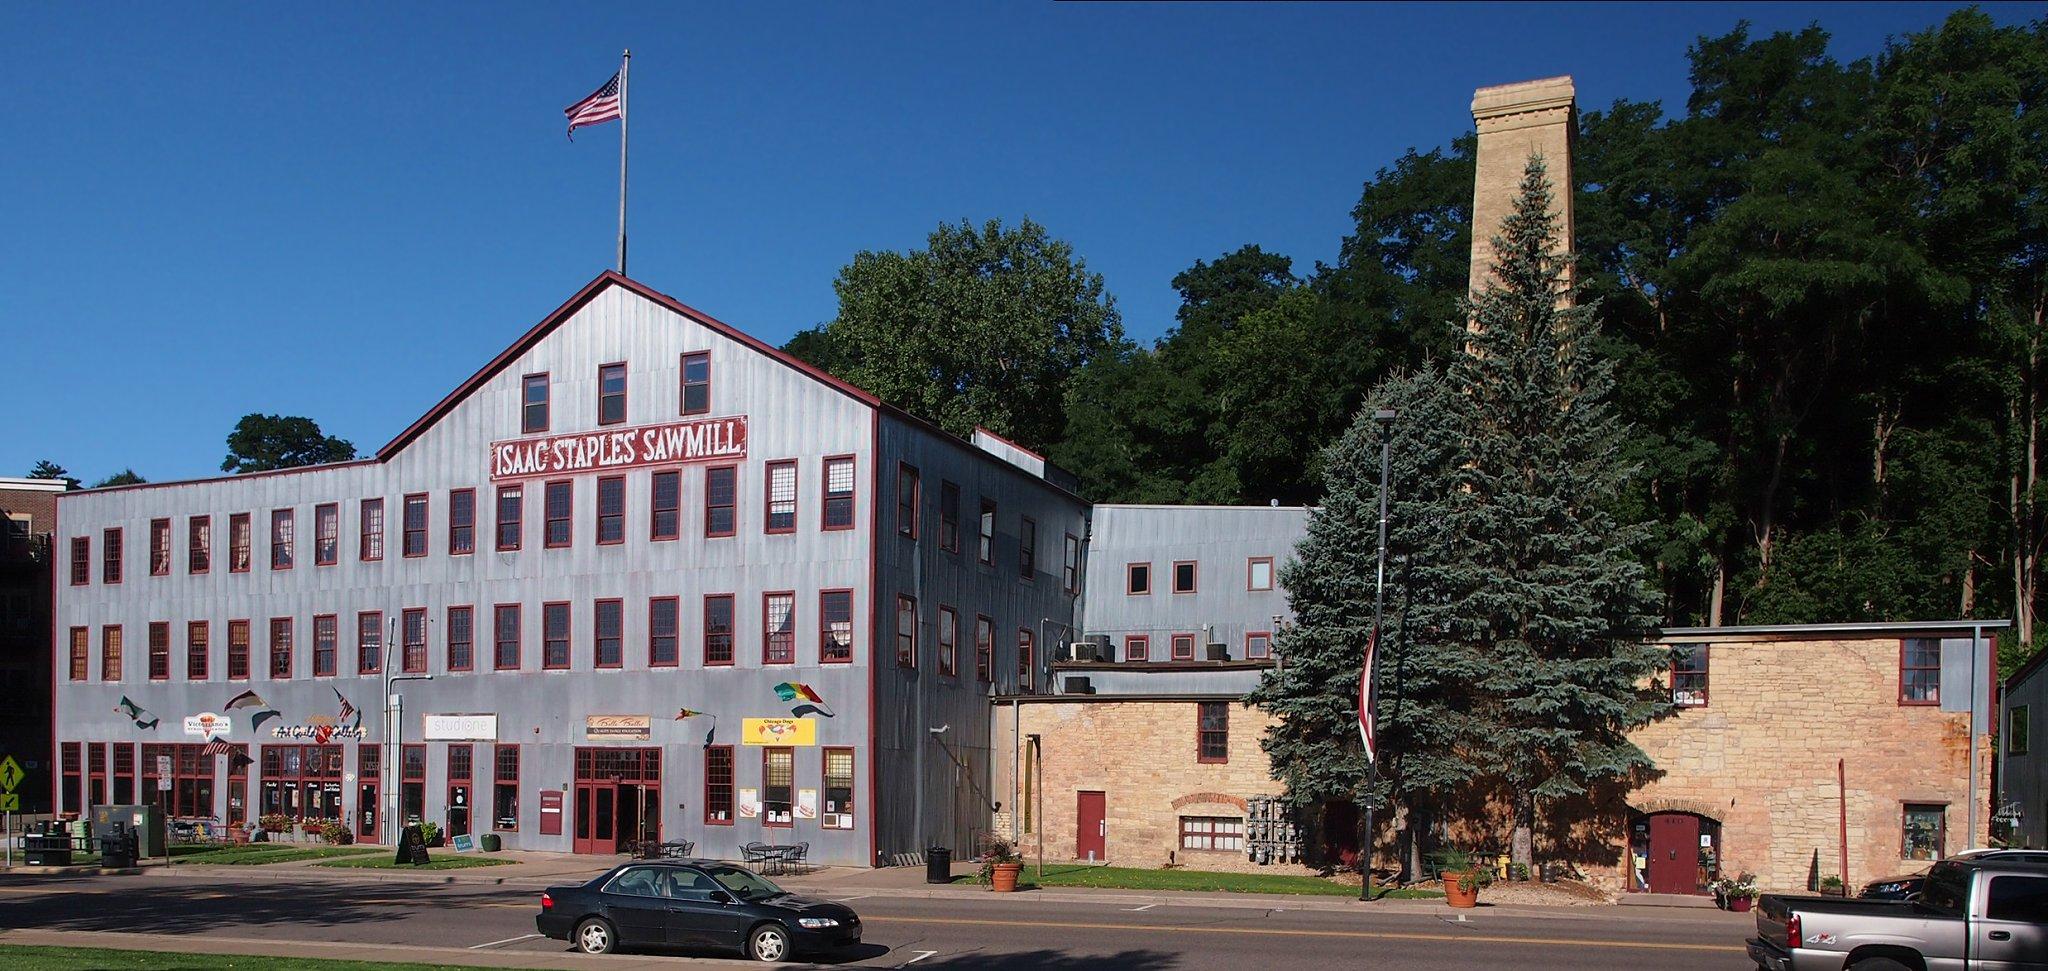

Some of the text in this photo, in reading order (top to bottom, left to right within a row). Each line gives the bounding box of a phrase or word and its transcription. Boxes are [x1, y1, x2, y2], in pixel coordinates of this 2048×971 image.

[496, 422, 741, 476] ISAAC STAPLES' SAWMILL
